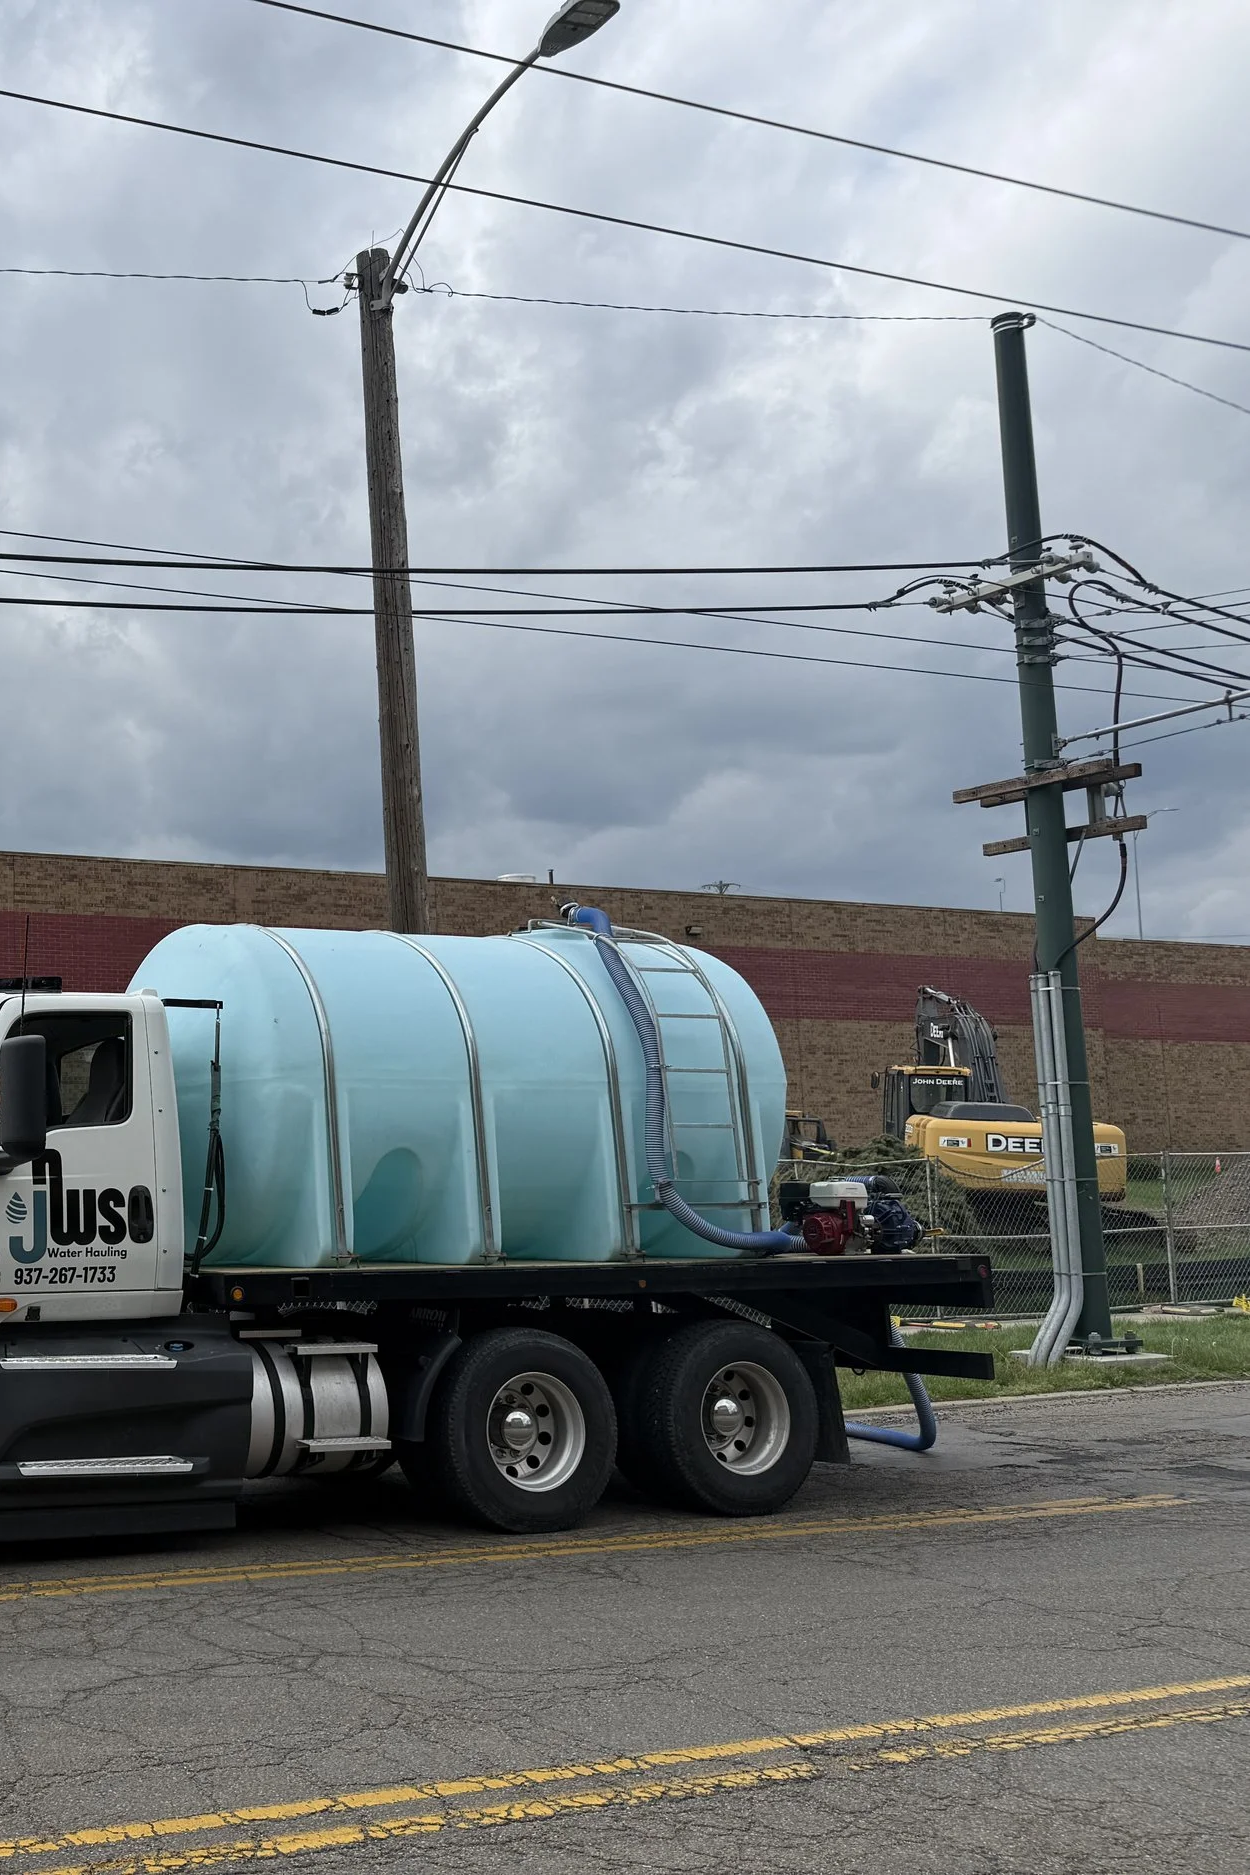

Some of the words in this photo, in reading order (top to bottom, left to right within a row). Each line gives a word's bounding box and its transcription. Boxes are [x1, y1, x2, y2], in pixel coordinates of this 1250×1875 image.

[936, 1078, 964, 1086] DEERE
[987, 1133, 1044, 1153] DEE
[47, 1247, 83, 1258] Water
[85, 1246, 127, 1259] Hauling
[13, 1265, 117, 1286] 937-267-1733
